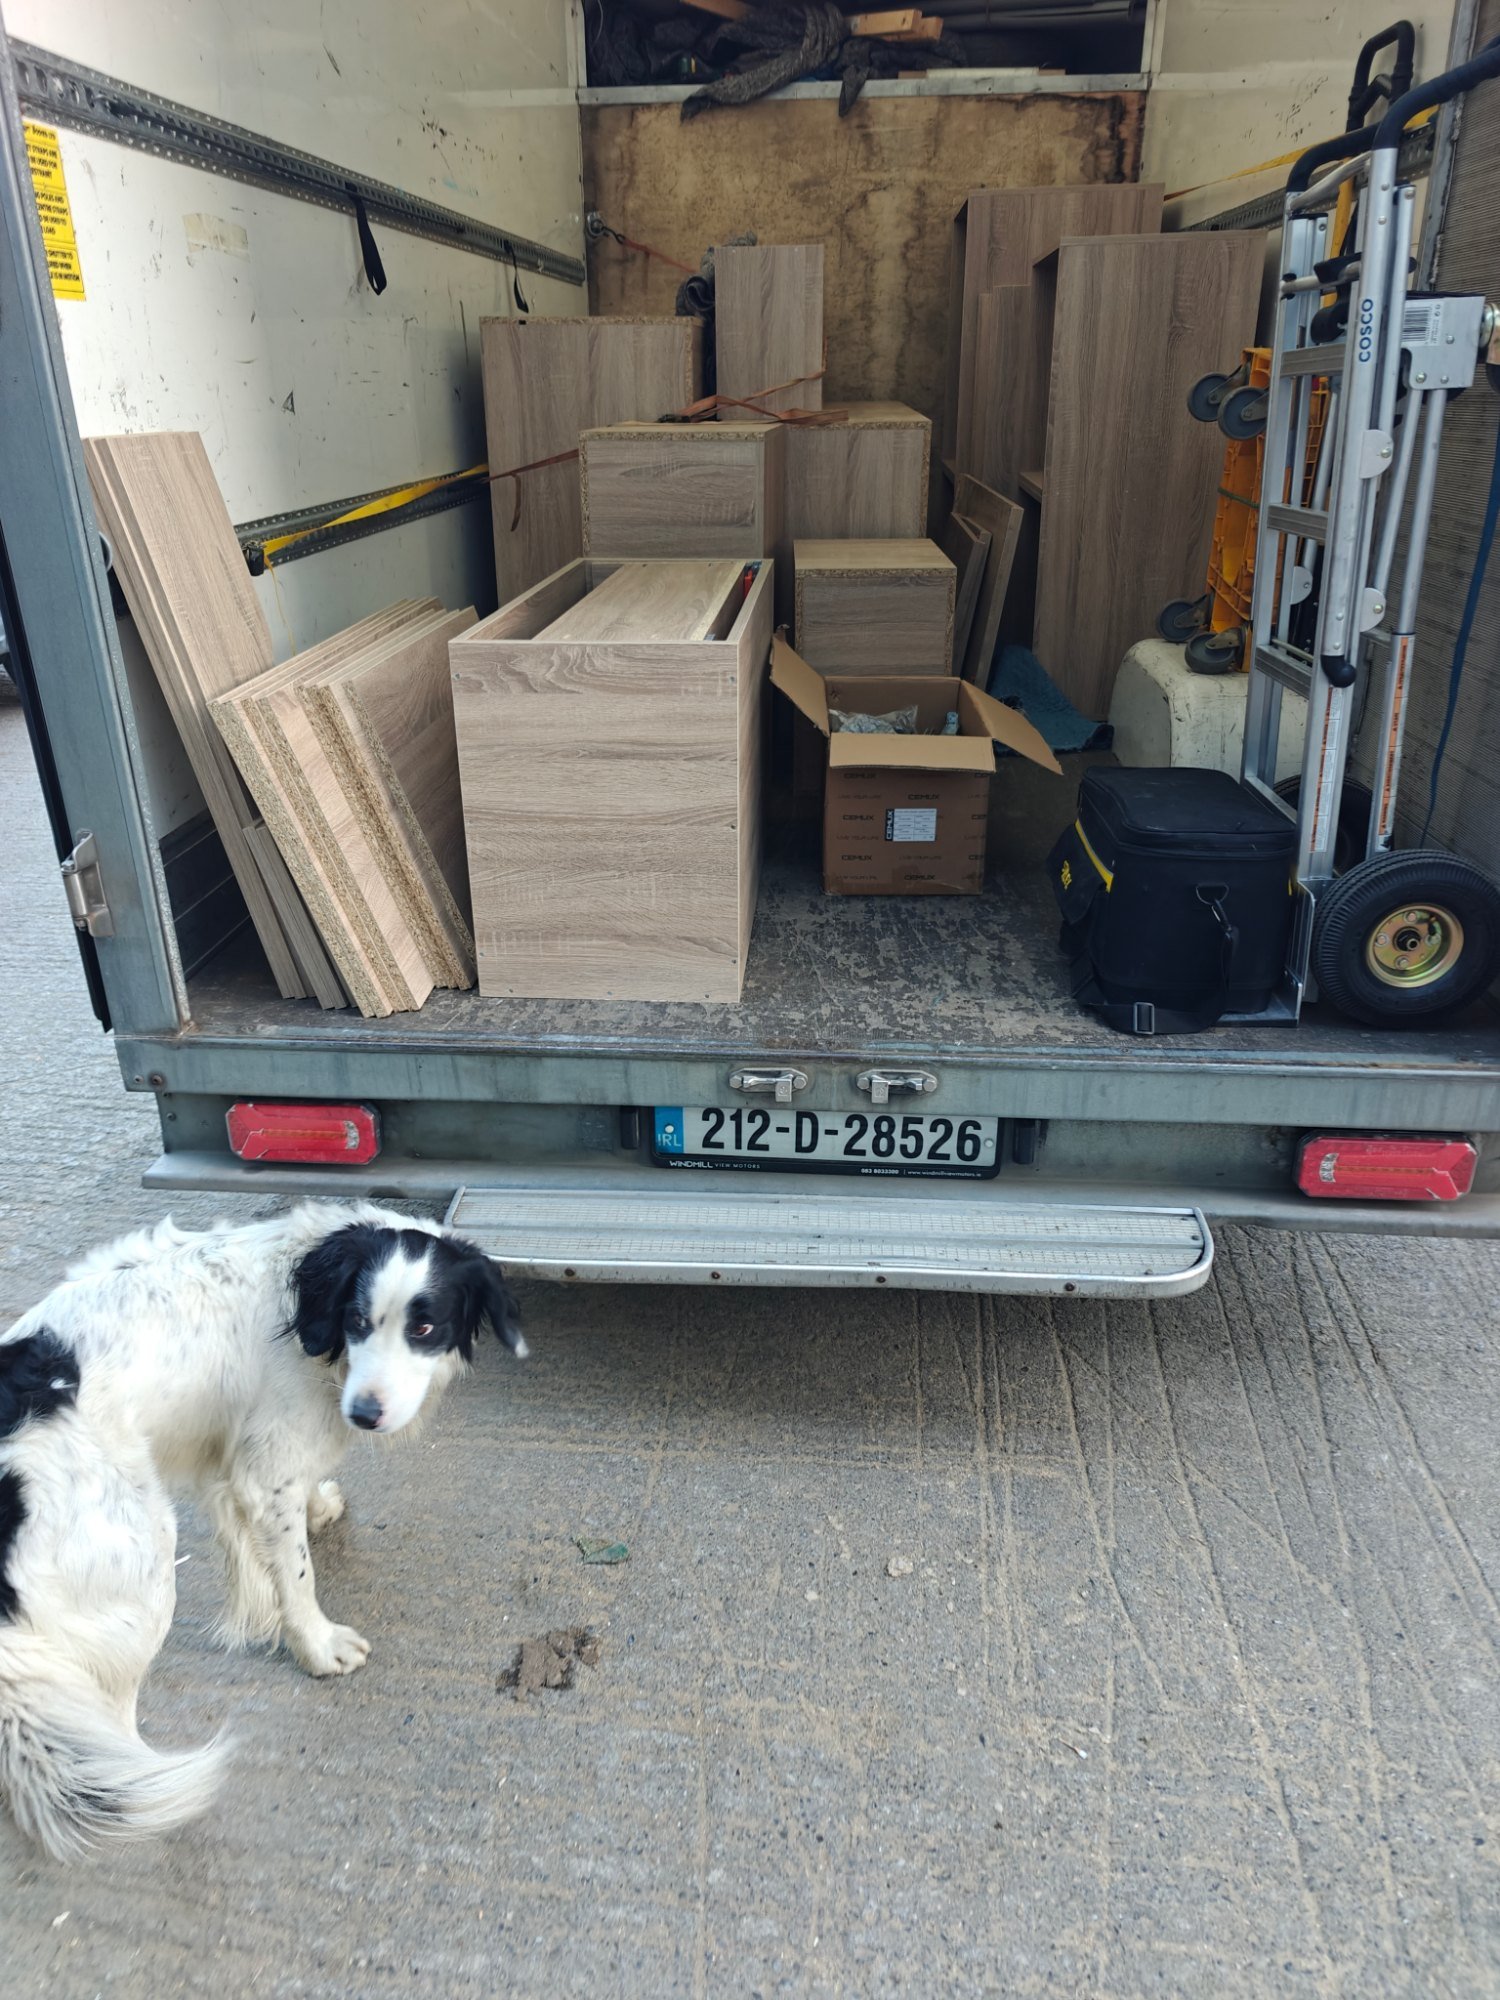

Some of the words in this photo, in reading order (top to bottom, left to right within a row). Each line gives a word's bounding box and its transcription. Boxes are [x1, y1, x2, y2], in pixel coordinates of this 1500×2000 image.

[1358, 298, 1374, 363] COSCO
[657, 1133, 682, 1147] IRL
[701, 1107, 982, 1162] 212-D-28526
[669, 1160, 713, 1168] WINDMILL
